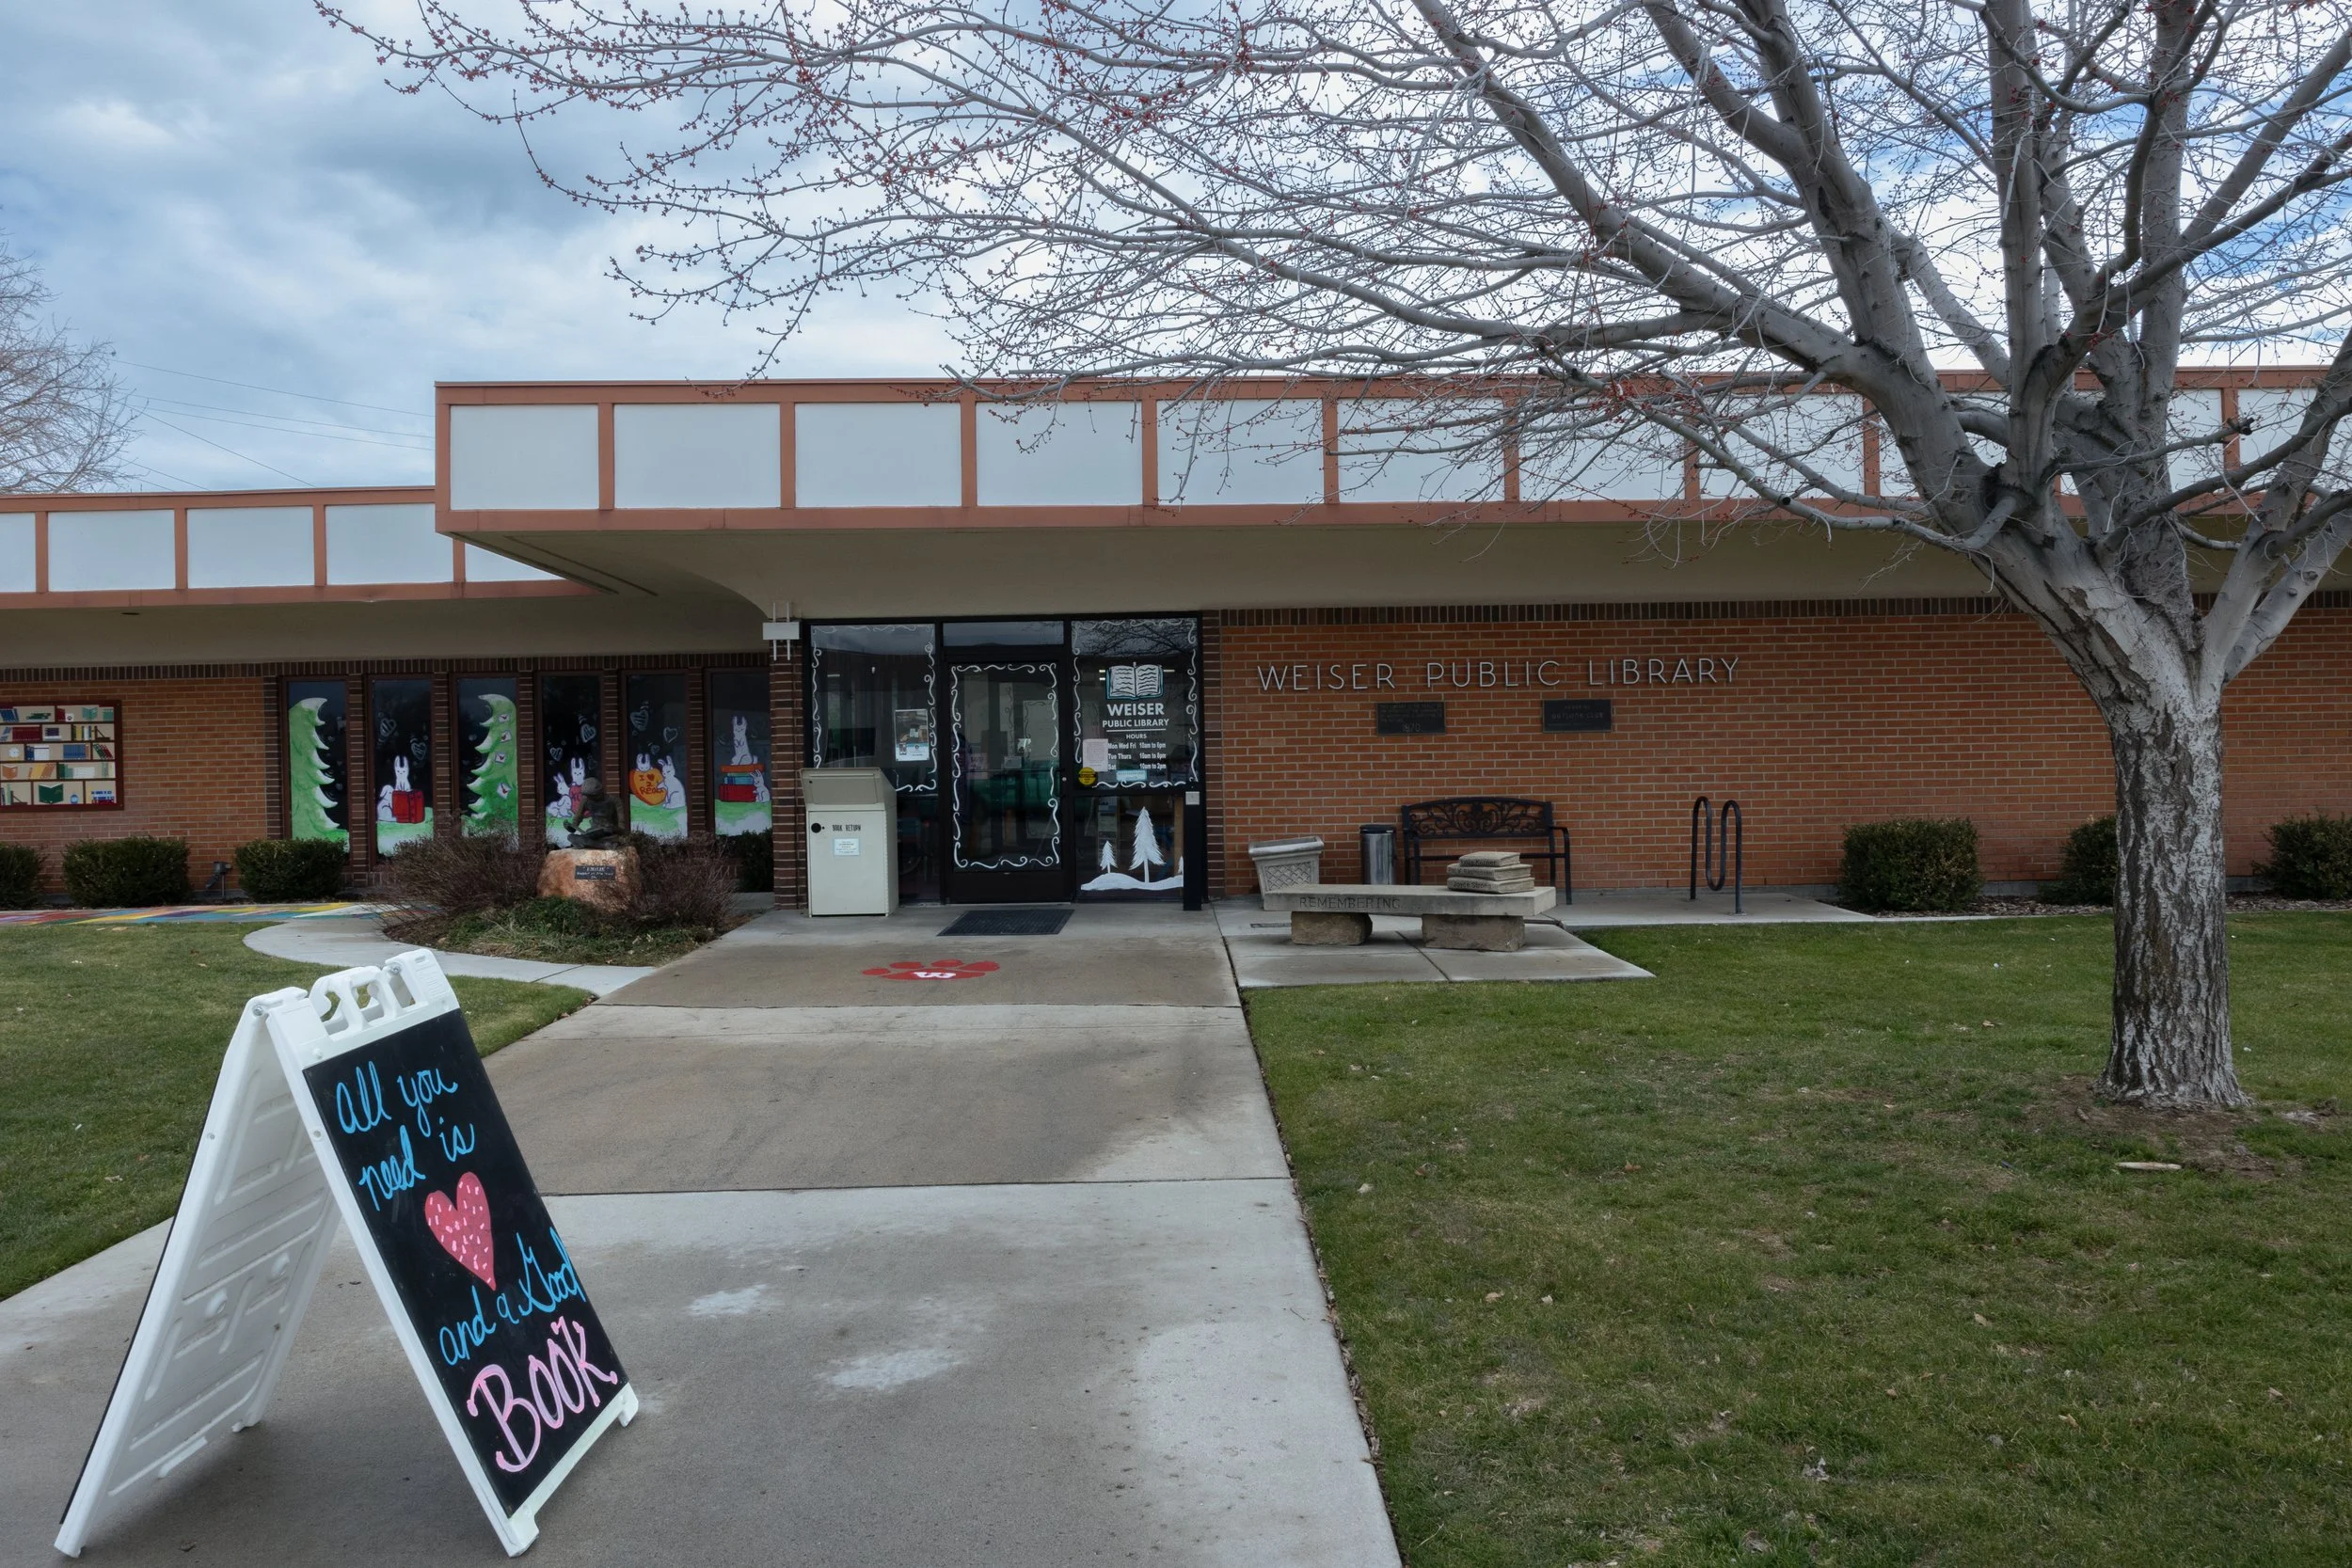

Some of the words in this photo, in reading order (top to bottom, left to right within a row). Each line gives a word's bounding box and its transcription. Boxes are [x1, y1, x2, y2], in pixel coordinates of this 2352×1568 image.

[1257, 663, 1396, 692] WEISER
[1426, 660, 1562, 689] PUBLIC
[1589, 657, 1740, 687] LIBRARY
[1103, 720, 1132, 728] PUBLIC
[1134, 719, 1169, 727] LIBRARY
[1107, 703, 1165, 716] WEISER
[1299, 896, 1401, 909] REMEMBERING
[397, 1068, 459, 1138] you
[358, 1124, 426, 1212] need
[438, 1116, 476, 1163] is
[439, 1285, 497, 1366] and
[497, 1292, 519, 1324] a
